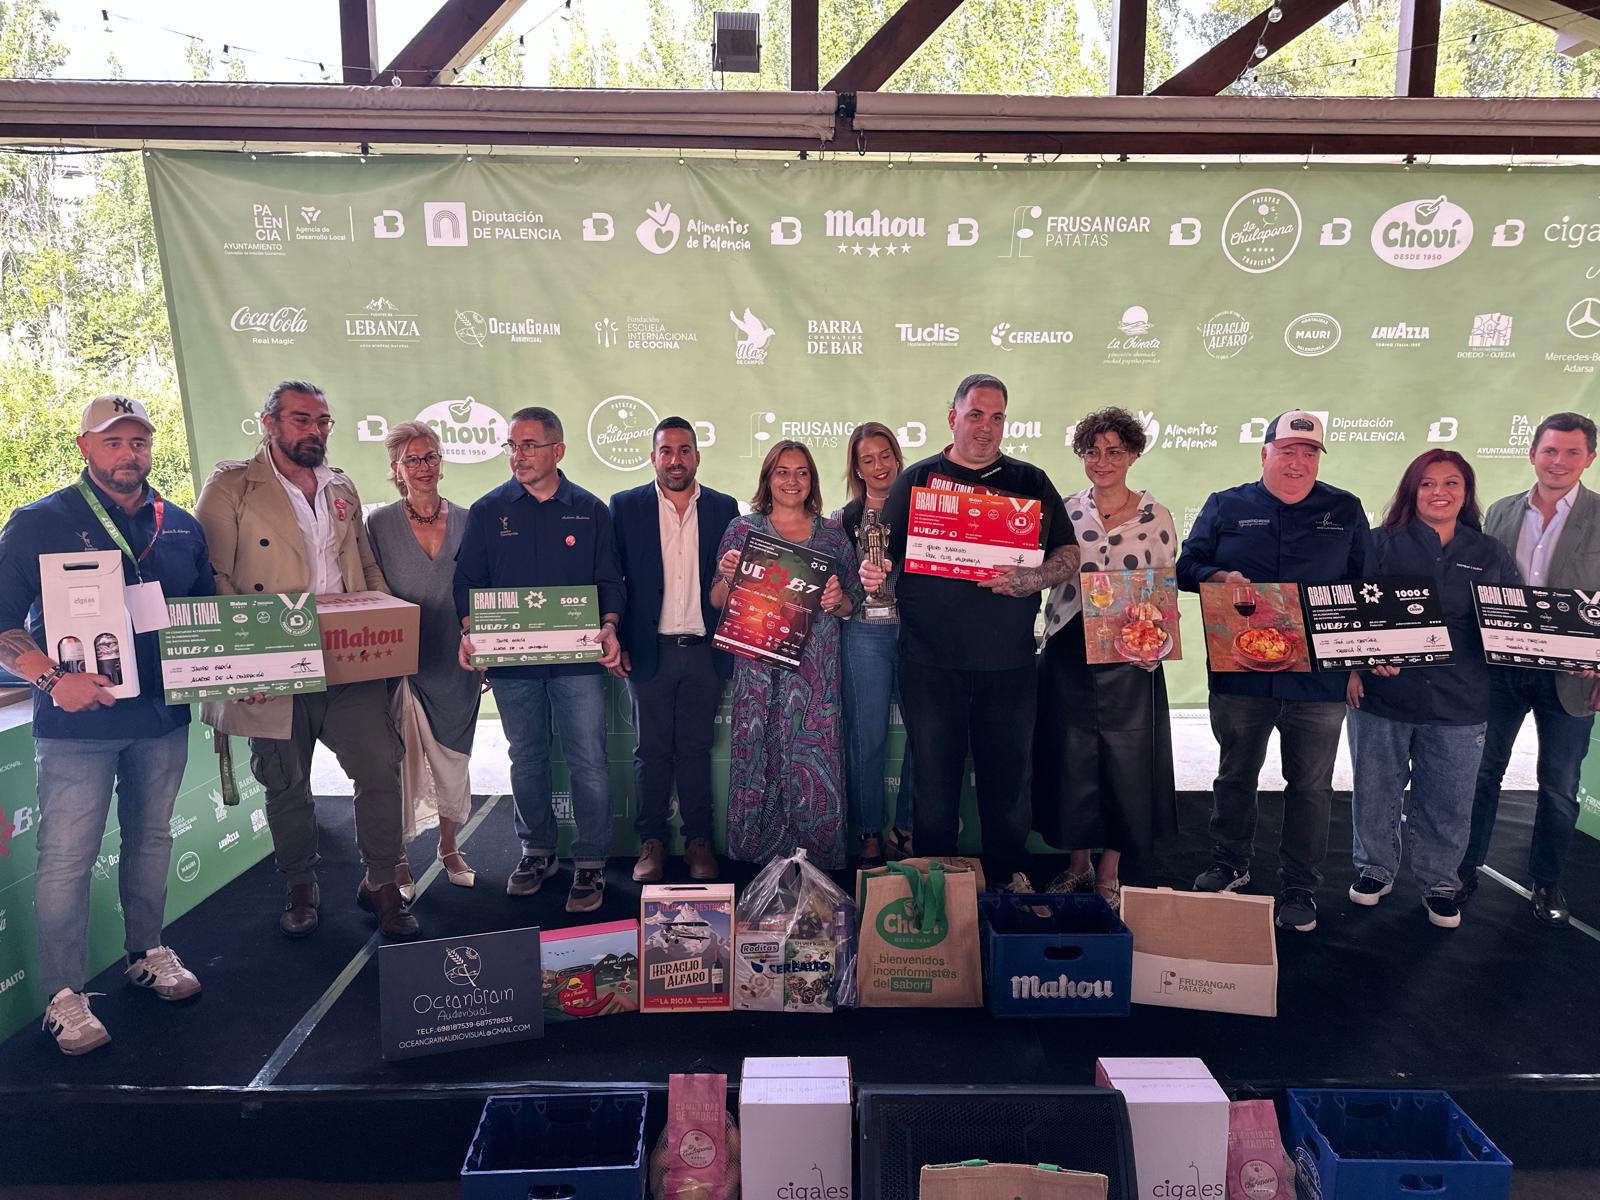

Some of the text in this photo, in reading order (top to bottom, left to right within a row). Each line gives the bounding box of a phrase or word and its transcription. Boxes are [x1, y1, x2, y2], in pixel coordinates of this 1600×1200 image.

[252, 203, 273, 217] PA
[472, 210, 544, 225] Diputación
[254, 217, 283, 229] LEN
[295, 225, 330, 235] Agencia de
[686, 218, 750, 235] Alimentos
[824, 208, 926, 238] Mahou
[1046, 215, 1151, 233] FRUSANGAR
[1242, 220, 1257, 233] La
[256, 229, 281, 241] CIA
[295, 233, 347, 242] Desarrollo Local
[473, 227, 562, 242] DE PALENCIA
[1045, 233, 1109, 248] PATATAS
[1230, 224, 1294, 246] Chulapona
[1382, 219, 1463, 249] Choví
[223, 242, 283, 251] AYUNTAMIENTO
[686, 234, 751, 252] de Palencia
[230, 306, 308, 333] Coca-Cola
[807, 320, 864, 334] BARRA
[345, 319, 421, 337] LEBANZA
[627, 323, 666, 332] ESCUELA
[895, 322, 960, 342] Tudis
[1202, 321, 1250, 338] HERACLIO
[1295, 330, 1331, 340] MAURI
[1371, 322, 1430, 339] LAVAZZA
[252, 337, 295, 347] Real Magic
[627, 331, 699, 341] INTERNACIONAL
[1008, 331, 1074, 344] CEREALTO
[1106, 335, 1162, 350] La Chinata
[1208, 333, 1248, 351] ALFARO
[627, 340, 680, 350] DE COCINA
[807, 340, 864, 355] DE BAR
[1563, 364, 1595, 374] Adarsa
[1331, 416, 1394, 431] Diputación
[1511, 414, 1528, 425] PA
[782, 421, 864, 436] FRUSANG
[1164, 419, 1219, 437] Alimentos
[1510, 425, 1536, 436] LEN
[1161, 436, 1219, 452] de Palencia
[1330, 431, 1406, 443] DE PALENCIA
[1508, 435, 1531, 446] CIA
[915, 491, 960, 515] GRAN FINAL
[474, 591, 520, 610] GRAN FINAL
[560, 596, 588, 605] 500 €
[1307, 583, 1356, 607] GRAN FINAL
[1394, 588, 1430, 599] 1000 €
[1477, 584, 1528, 608] GRAN FINAL
[168, 601, 222, 627] RAN FINAL
[324, 626, 404, 651] Mahou
[742, 943, 778, 954] Roditas
[879, 953, 945, 967] bienvenidos
[652, 959, 700, 979] HERACLIO
[873, 965, 958, 979] inconformist@s
[666, 971, 706, 988] ALFARO
[873, 978, 890, 989] del
[1010, 973, 1116, 999] Mahou
[1178, 977, 1236, 992] FRUSANGAR
[1178, 984, 1214, 996] PATATAS
[412, 987, 515, 1014] OceanGrain
[659, 996, 693, 1006] LA RIOJA
